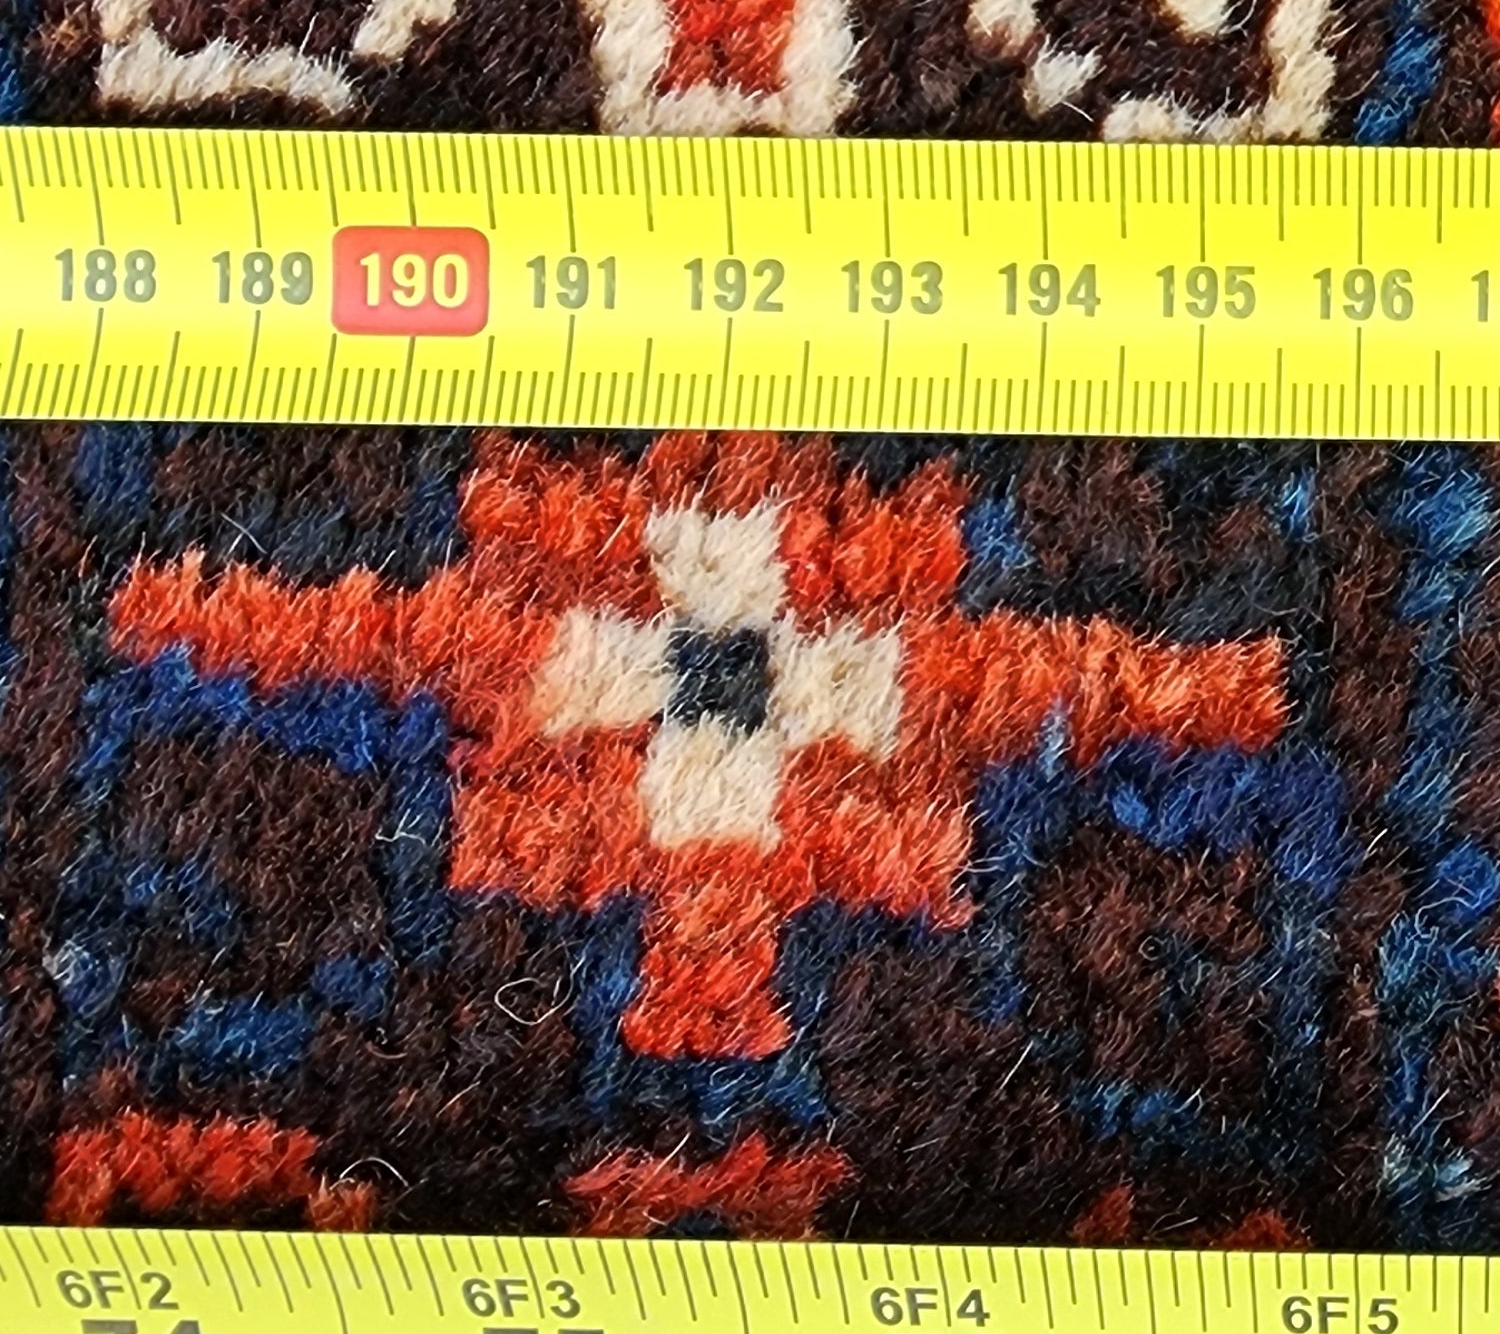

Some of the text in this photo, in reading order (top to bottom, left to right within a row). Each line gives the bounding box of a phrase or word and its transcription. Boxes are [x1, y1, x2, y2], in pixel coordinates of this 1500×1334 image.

[55, 249, 156, 302] 188
[212, 251, 313, 305] 189
[360, 253, 468, 308] 190
[527, 256, 615, 309] 191
[684, 258, 784, 312] 192
[842, 260, 942, 314] 193
[999, 263, 1101, 317] 194
[1156, 265, 1255, 318] 195
[1313, 268, 1413, 320] 196
